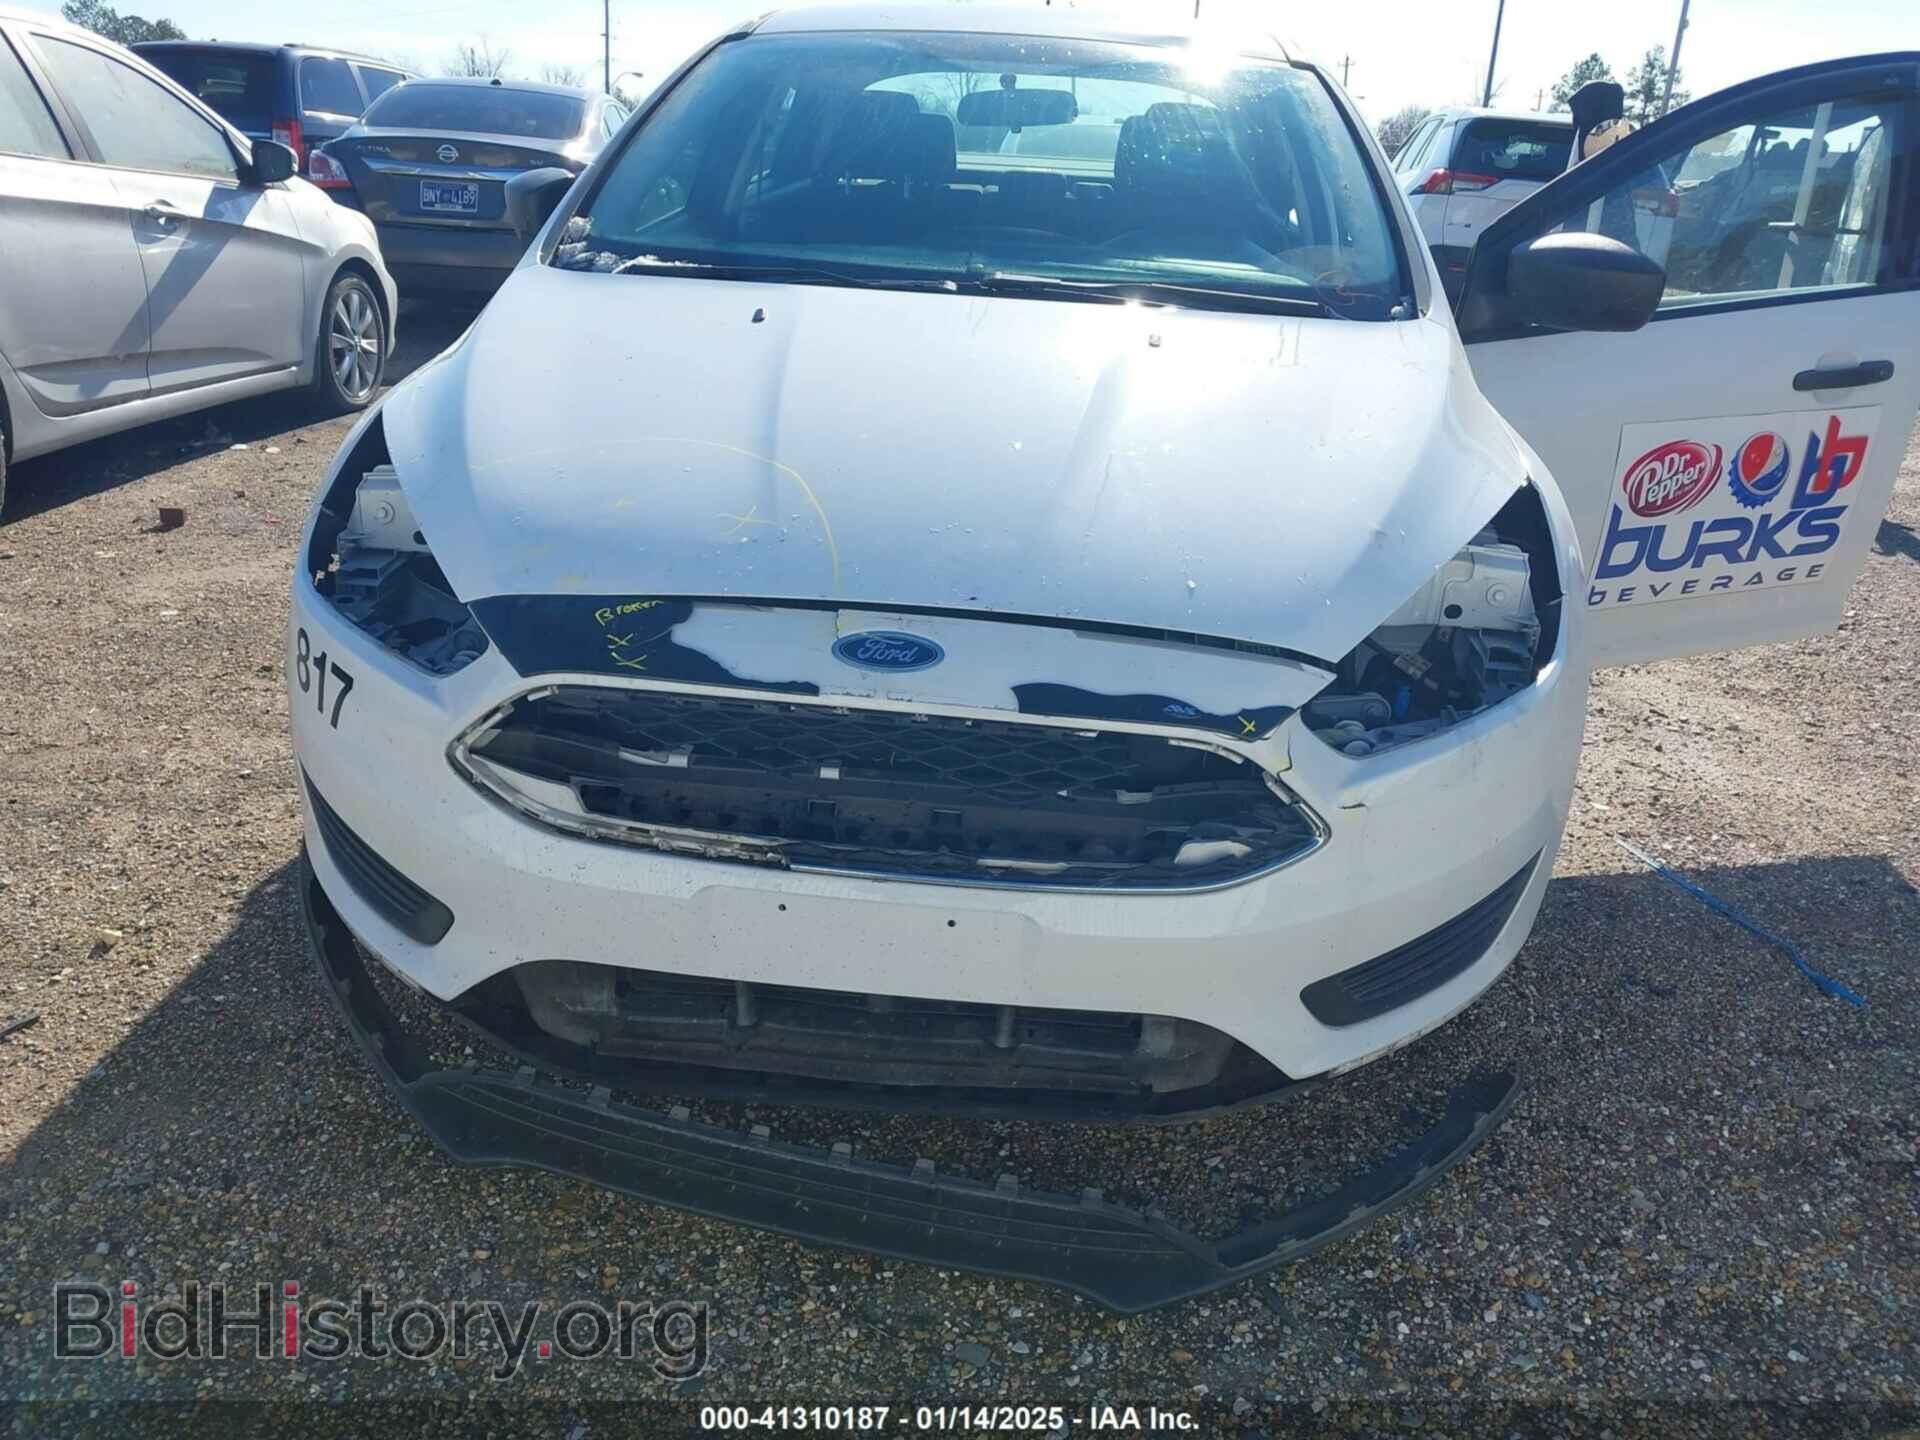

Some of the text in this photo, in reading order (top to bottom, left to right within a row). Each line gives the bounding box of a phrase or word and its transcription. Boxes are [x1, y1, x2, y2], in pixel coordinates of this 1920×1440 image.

[451, 190, 475, 204] 4189
[1662, 452, 1691, 481] Dr
[1638, 460, 1705, 508] Pepper
[856, 638, 919, 663] Ford
[296, 627, 354, 729] 817
